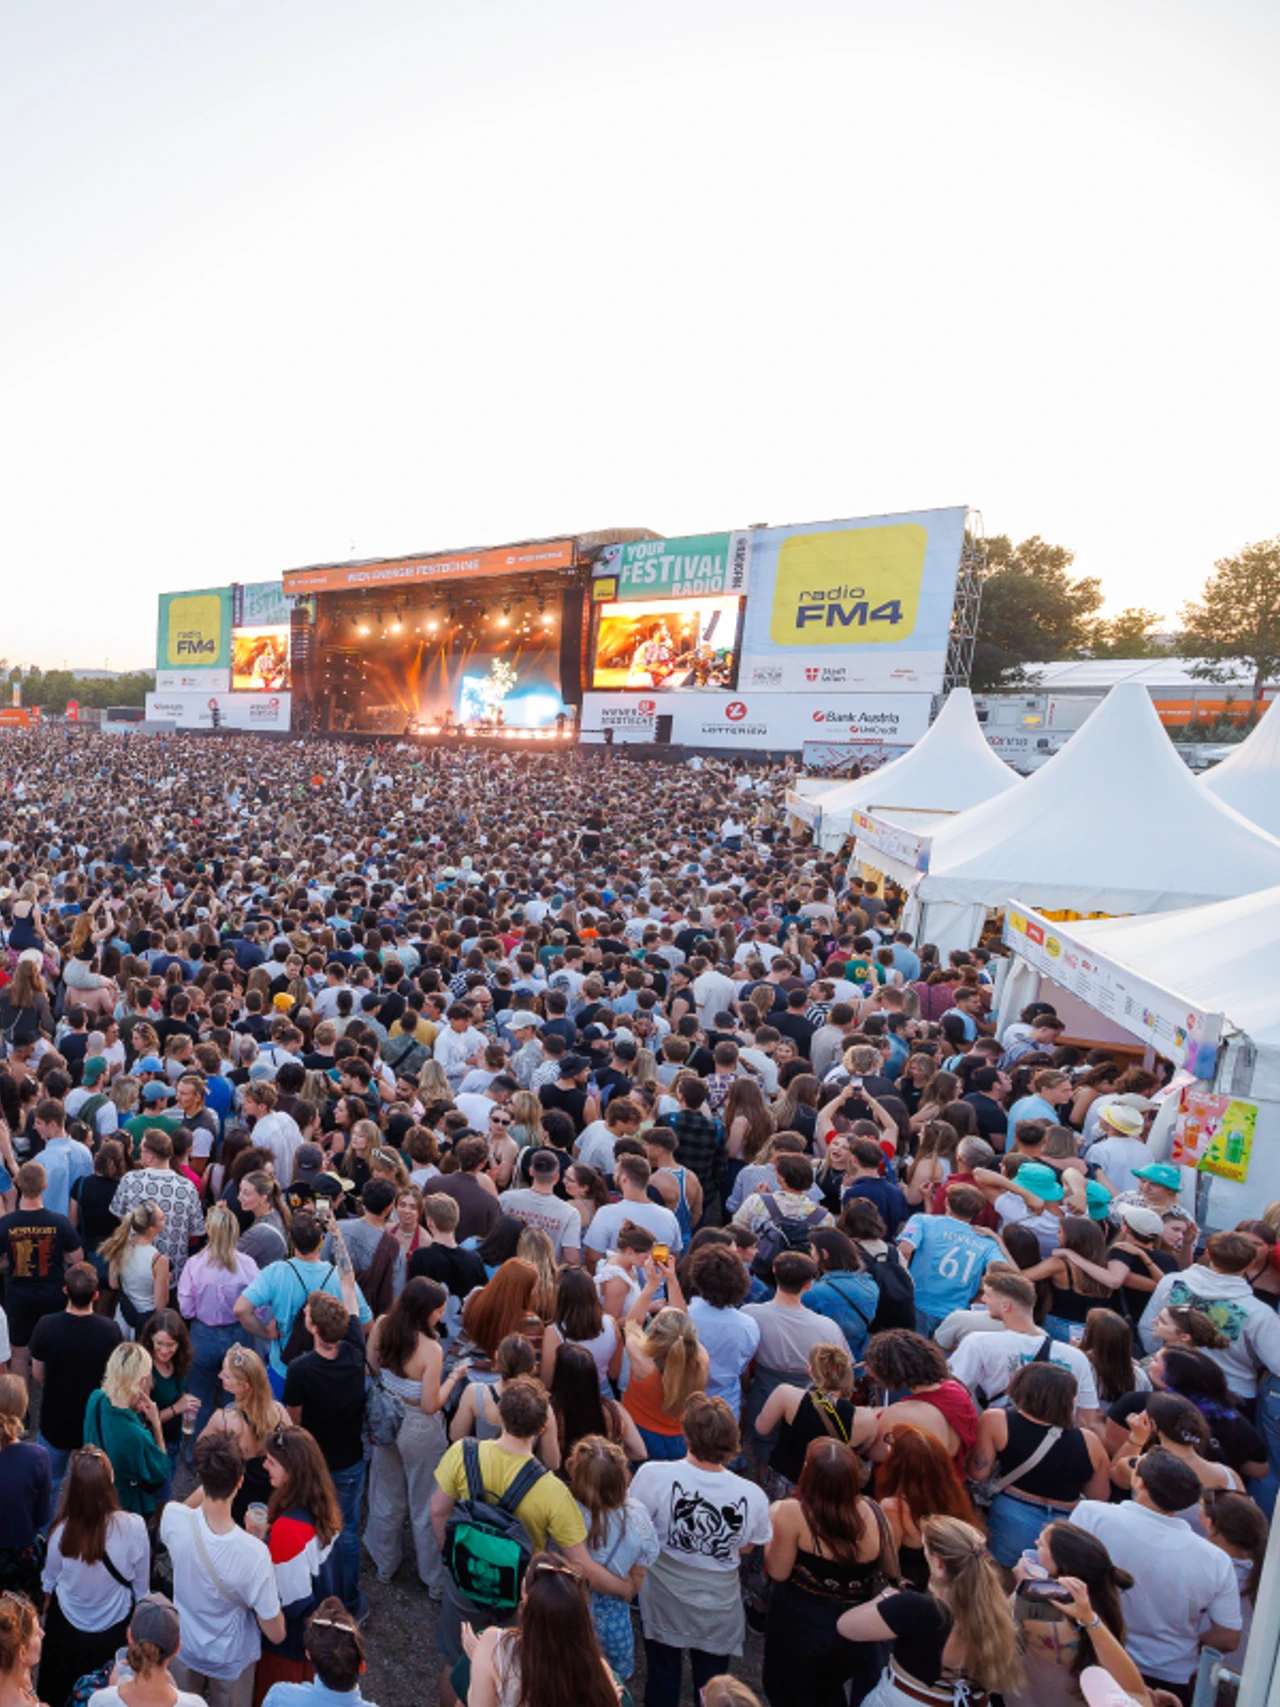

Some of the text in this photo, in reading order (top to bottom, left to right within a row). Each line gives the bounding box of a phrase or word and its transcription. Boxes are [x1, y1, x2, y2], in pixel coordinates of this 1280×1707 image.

[628, 541, 666, 562] YOUR
[416, 558, 480, 577] FESTBÜHNE
[621, 554, 724, 584] FESTIVAL
[671, 575, 722, 597] RADIO
[799, 584, 866, 602] radio
[795, 599, 904, 628] FM4
[177, 630, 201, 639] radio
[176, 639, 215, 655] FM4
[825, 711, 900, 724] Bank Austria
[859, 725, 898, 735] UniCredit
[938, 1245, 977, 1285] 61
